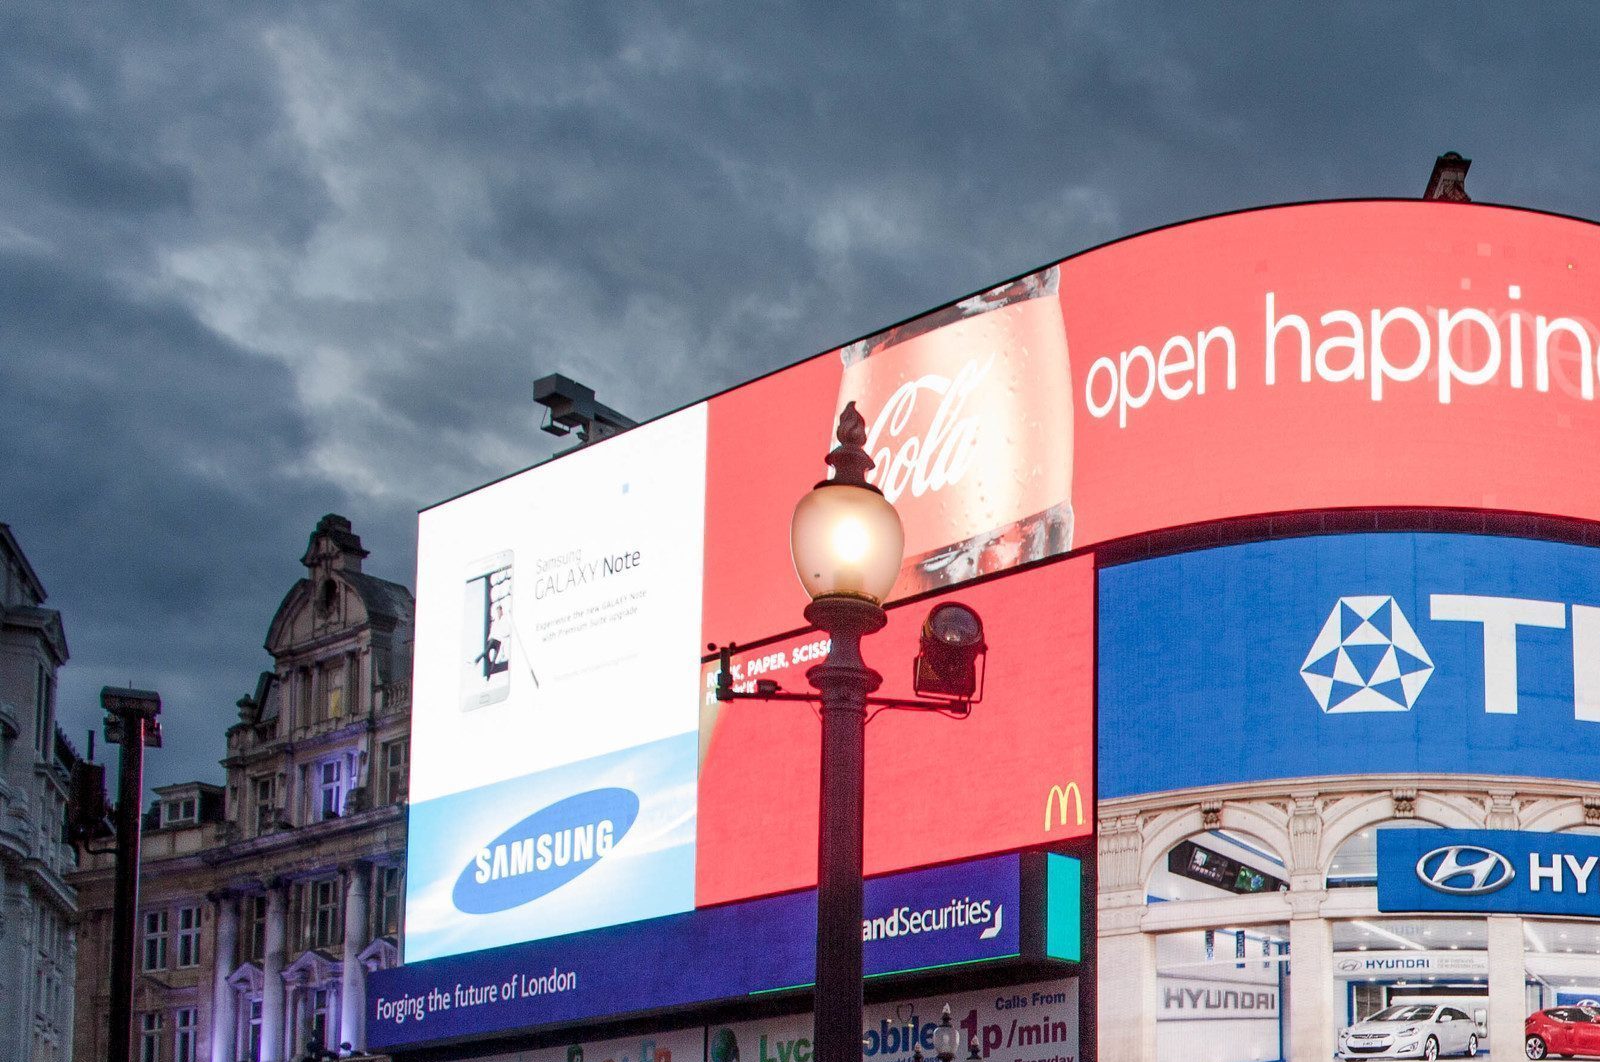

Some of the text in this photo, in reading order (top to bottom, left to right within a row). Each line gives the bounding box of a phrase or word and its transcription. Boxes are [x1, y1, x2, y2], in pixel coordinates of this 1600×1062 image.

[1086, 325, 1237, 429] open
[603, 550, 641, 577] Note
[747, 652, 789, 677] PAPER,
[475, 819, 614, 885] SAMSUNG
[862, 896, 991, 942] andSecurities
[1365, 958, 1430, 970] HYUNDAI
[376, 966, 577, 1024] Forging the future of London
[995, 990, 1066, 1011] Calls From
[1163, 987, 1275, 1011] HYUNDAI
